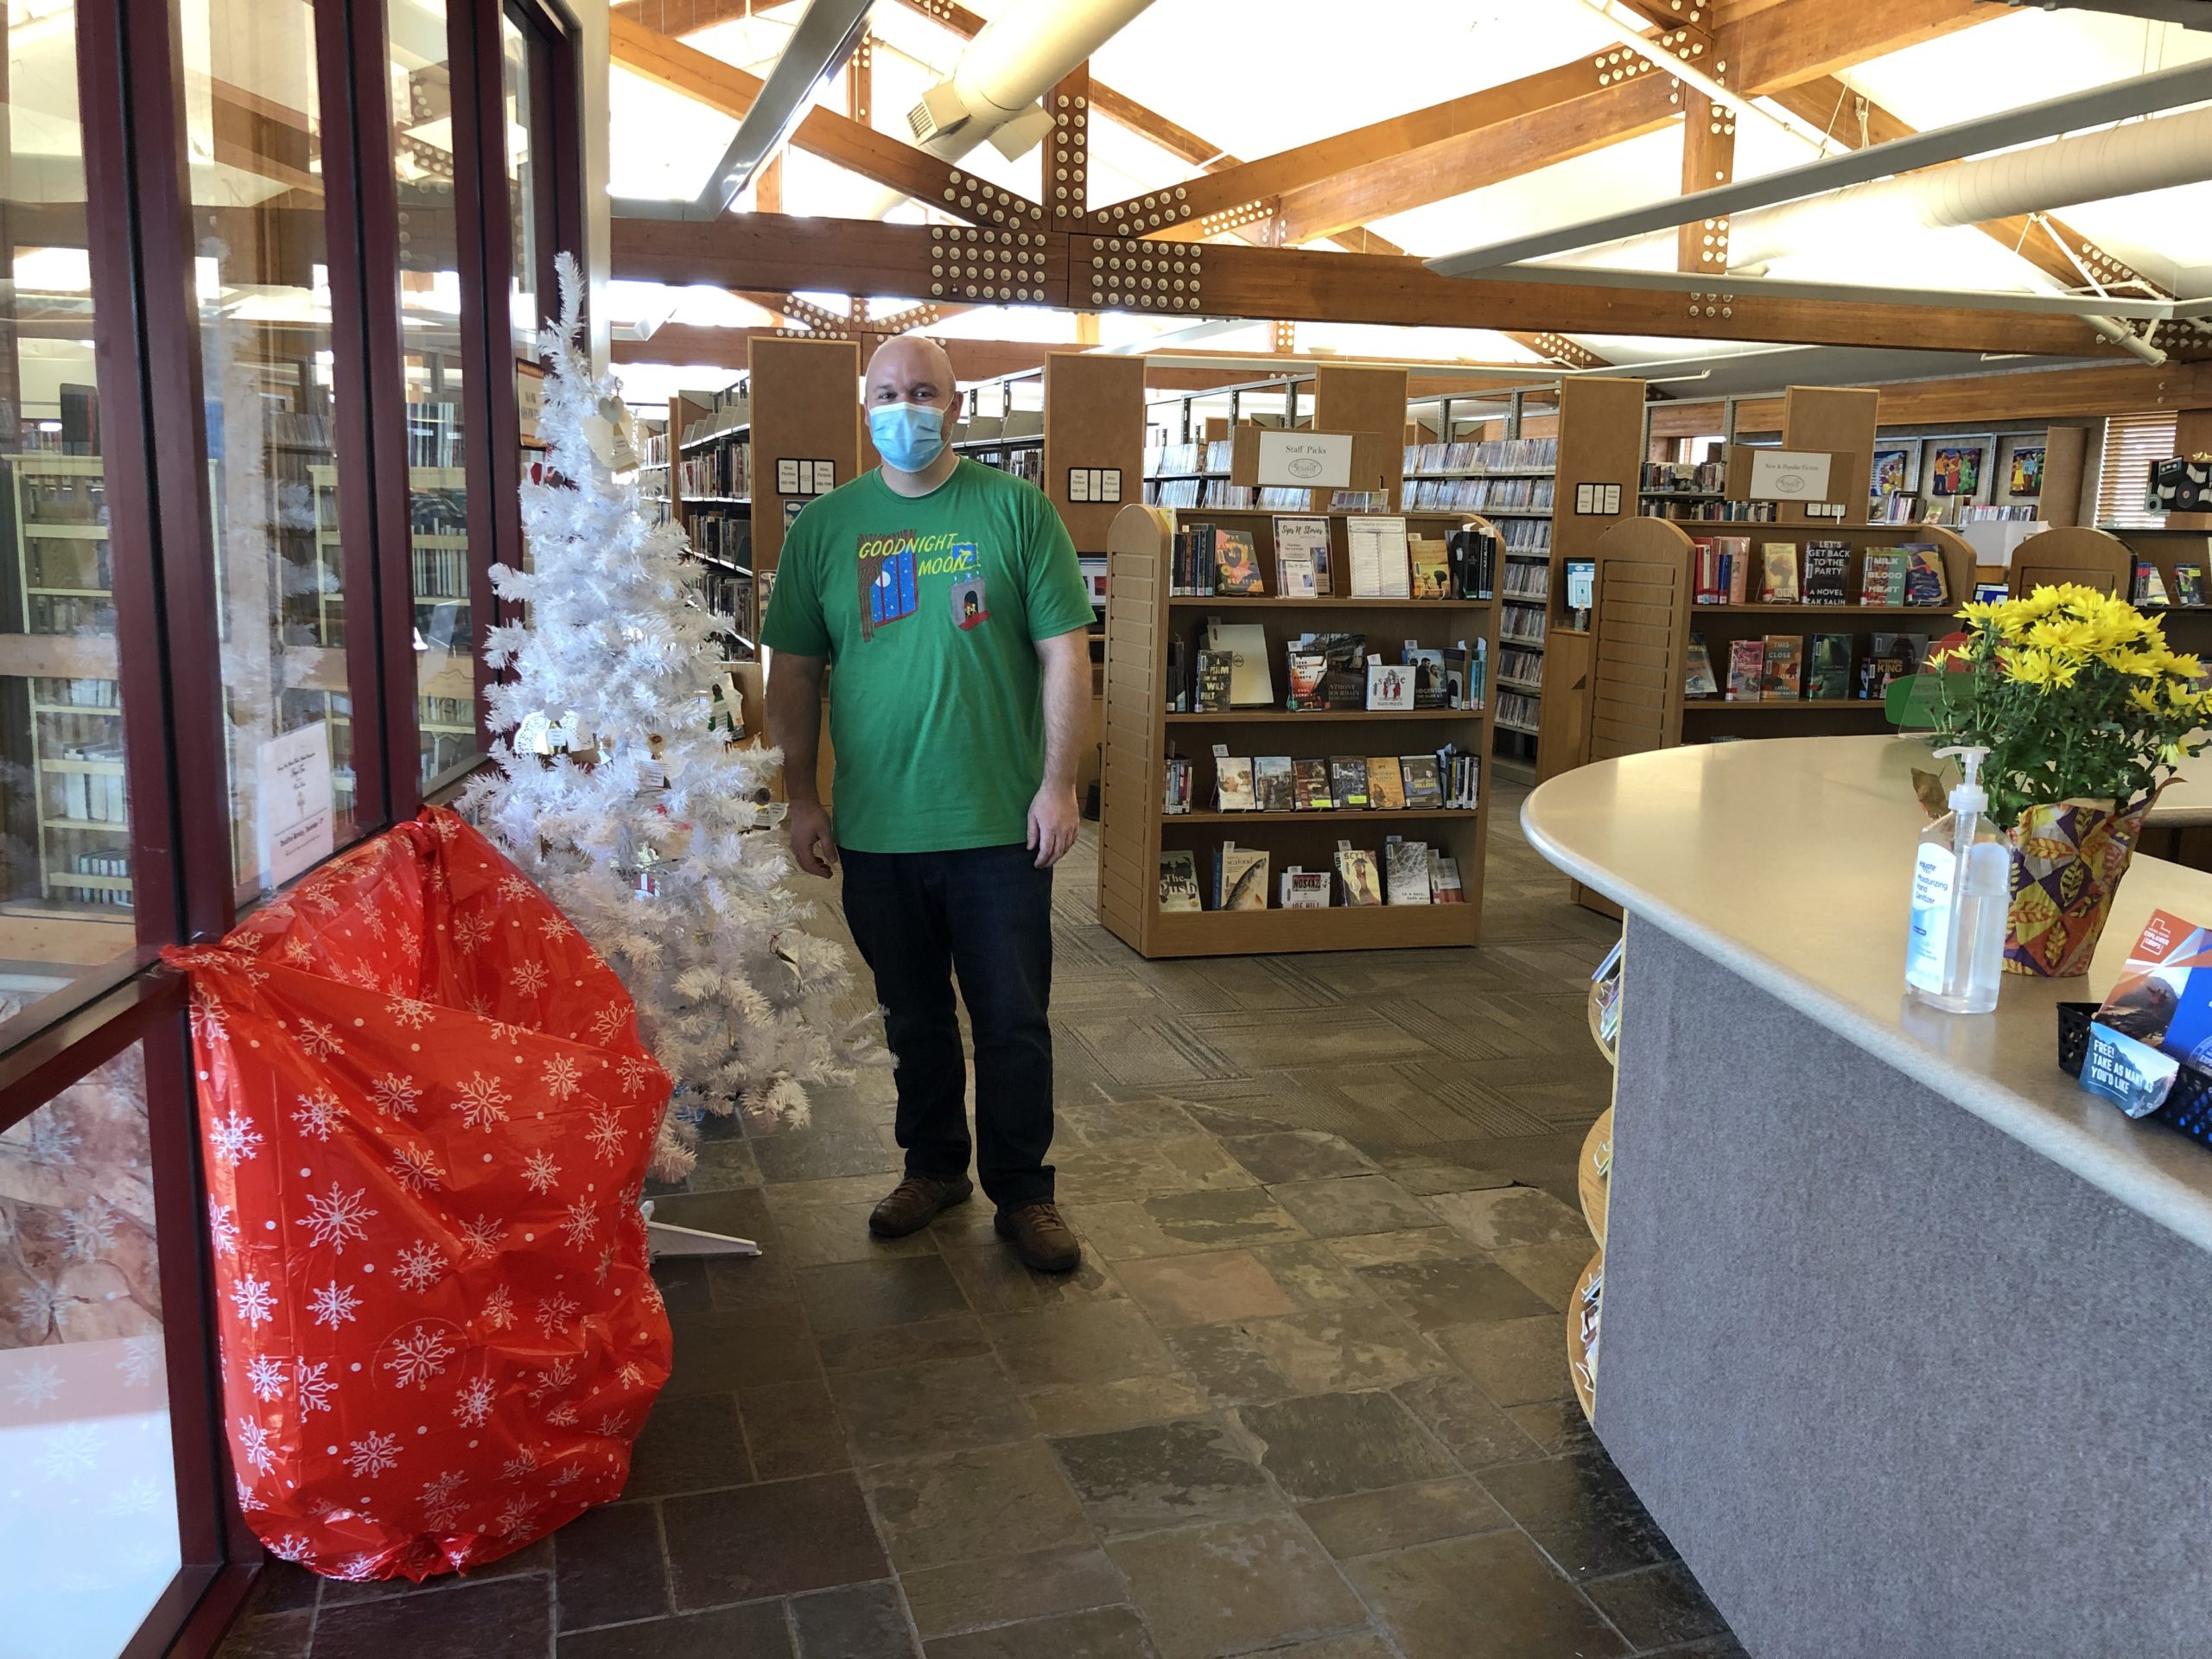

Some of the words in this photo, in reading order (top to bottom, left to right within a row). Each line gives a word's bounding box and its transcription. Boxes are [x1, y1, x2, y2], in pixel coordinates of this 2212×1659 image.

[1285, 445, 1303, 454] Staff
[1306, 446, 1327, 454] Picks
[1281, 524, 1294, 536] Sips
[1295, 525, 1301, 535] N
[1304, 524, 1323, 535] Stories
[859, 532, 958, 559] GOODNIGHT
[918, 556, 968, 576] MOON
[1226, 856, 1253, 865] seafood
[1919, 861, 1936, 872] equate
[1166, 874, 1185, 883] The
[1293, 879, 1320, 889] NOS4A2
[1917, 874, 1948, 891] Moisturizing
[1159, 881, 1197, 895] Push
[1916, 883, 1928, 893] Hand
[1916, 892, 1935, 904] Sanitizer
[2144, 930, 2171, 945] EXPLORER
[2145, 938, 2162, 950] CORPS
[2094, 1039, 2114, 1058] FREE!
[2093, 1052, 2113, 1071] TAKE
[2113, 1062, 2125, 1077] AS
[2125, 1067, 2144, 1087] MANY
[2145, 1079, 2155, 1093] AS
[2091, 1065, 2113, 1085] YOU'D
[2114, 1076, 2130, 1095] LIKE
